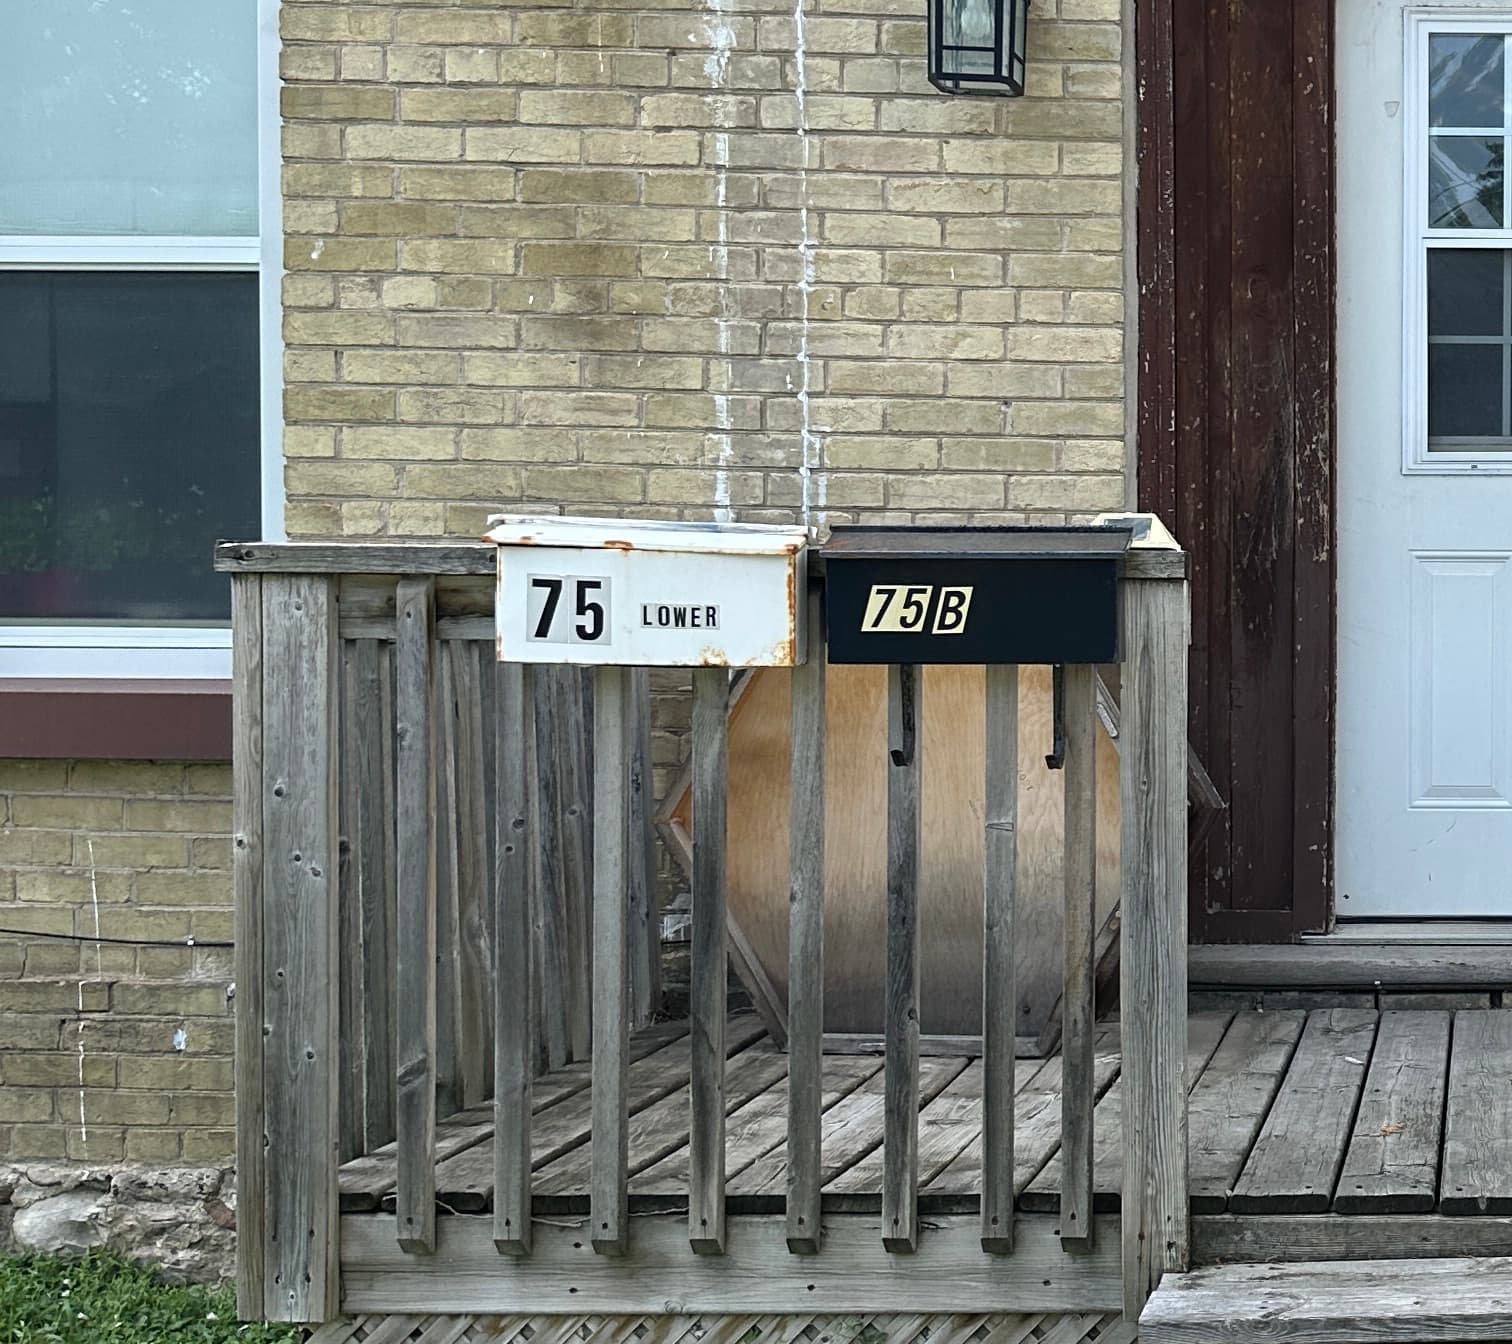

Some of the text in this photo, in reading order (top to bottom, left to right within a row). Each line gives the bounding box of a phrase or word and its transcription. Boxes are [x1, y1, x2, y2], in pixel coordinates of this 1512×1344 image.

[531, 578, 717, 641] 75 LOWER
[871, 588, 967, 631] 75B
